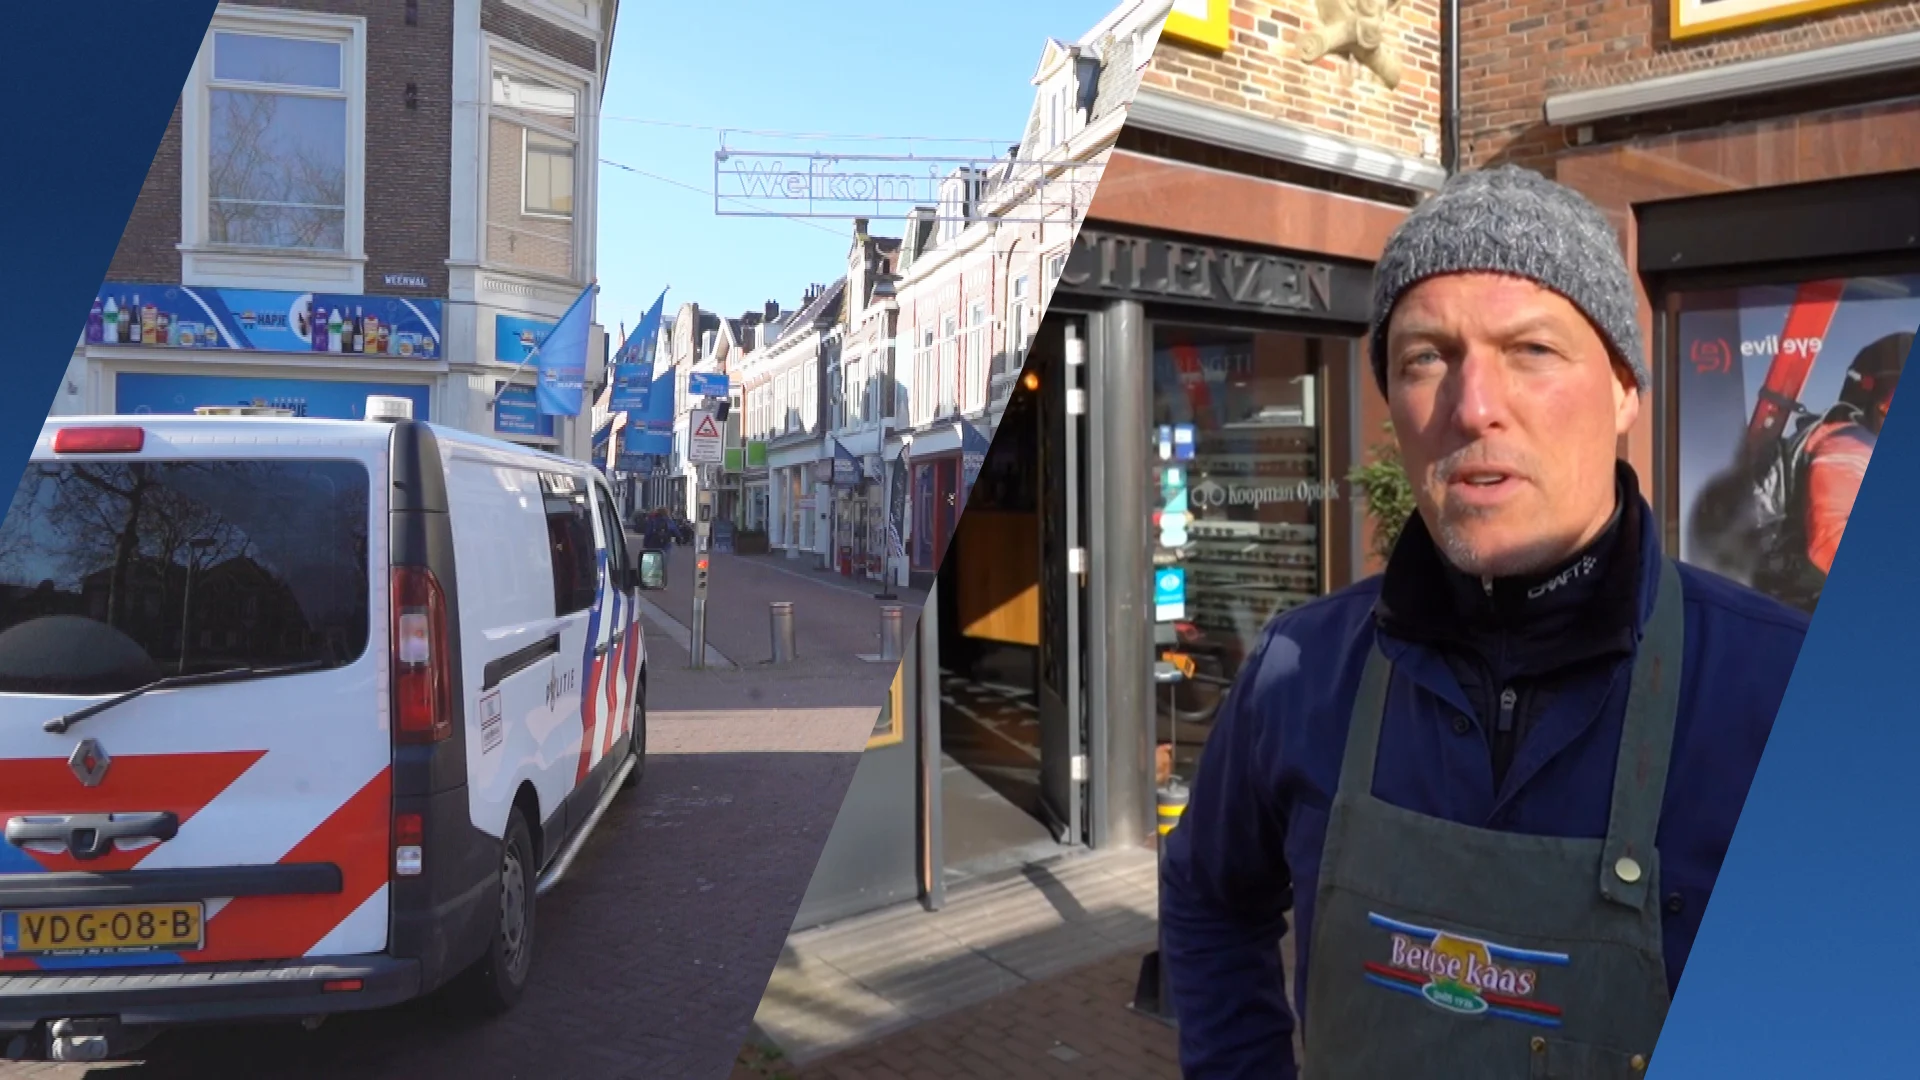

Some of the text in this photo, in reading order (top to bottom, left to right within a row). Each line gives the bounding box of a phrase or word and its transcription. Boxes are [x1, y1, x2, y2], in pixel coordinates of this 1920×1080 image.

[735, 158, 915, 201] Welkom
[1740, 334, 1823, 360] evil eye
[1228, 483, 1295, 510] Koopman
[1527, 561, 1582, 599] CRAFT
[25, 909, 191, 945] VDG-08-B
[1391, 934, 1536, 995] Beuse kaas
